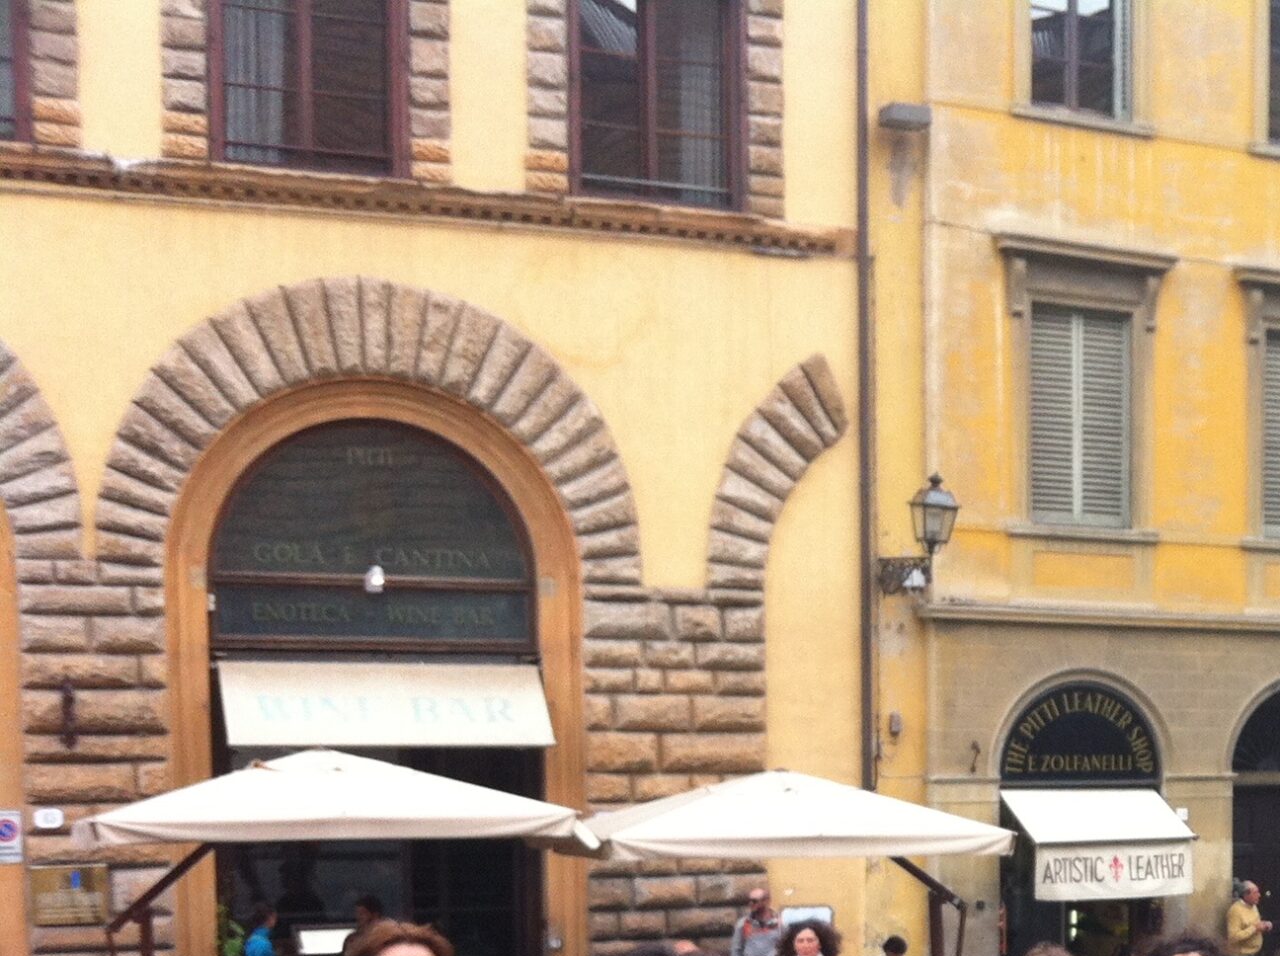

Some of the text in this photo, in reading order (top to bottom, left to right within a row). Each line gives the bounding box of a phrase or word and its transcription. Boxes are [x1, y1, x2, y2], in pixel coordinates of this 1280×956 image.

[253, 542, 325, 564] GOLA
[374, 546, 492, 570] CANTINA
[251, 602, 351, 622] ENOTECA
[410, 696, 515, 723] BAR
[1006, 691, 1154, 773] THE PITTI LEATHER SHOP
[1042, 852, 1186, 885] ARTISTIC LEATHER
